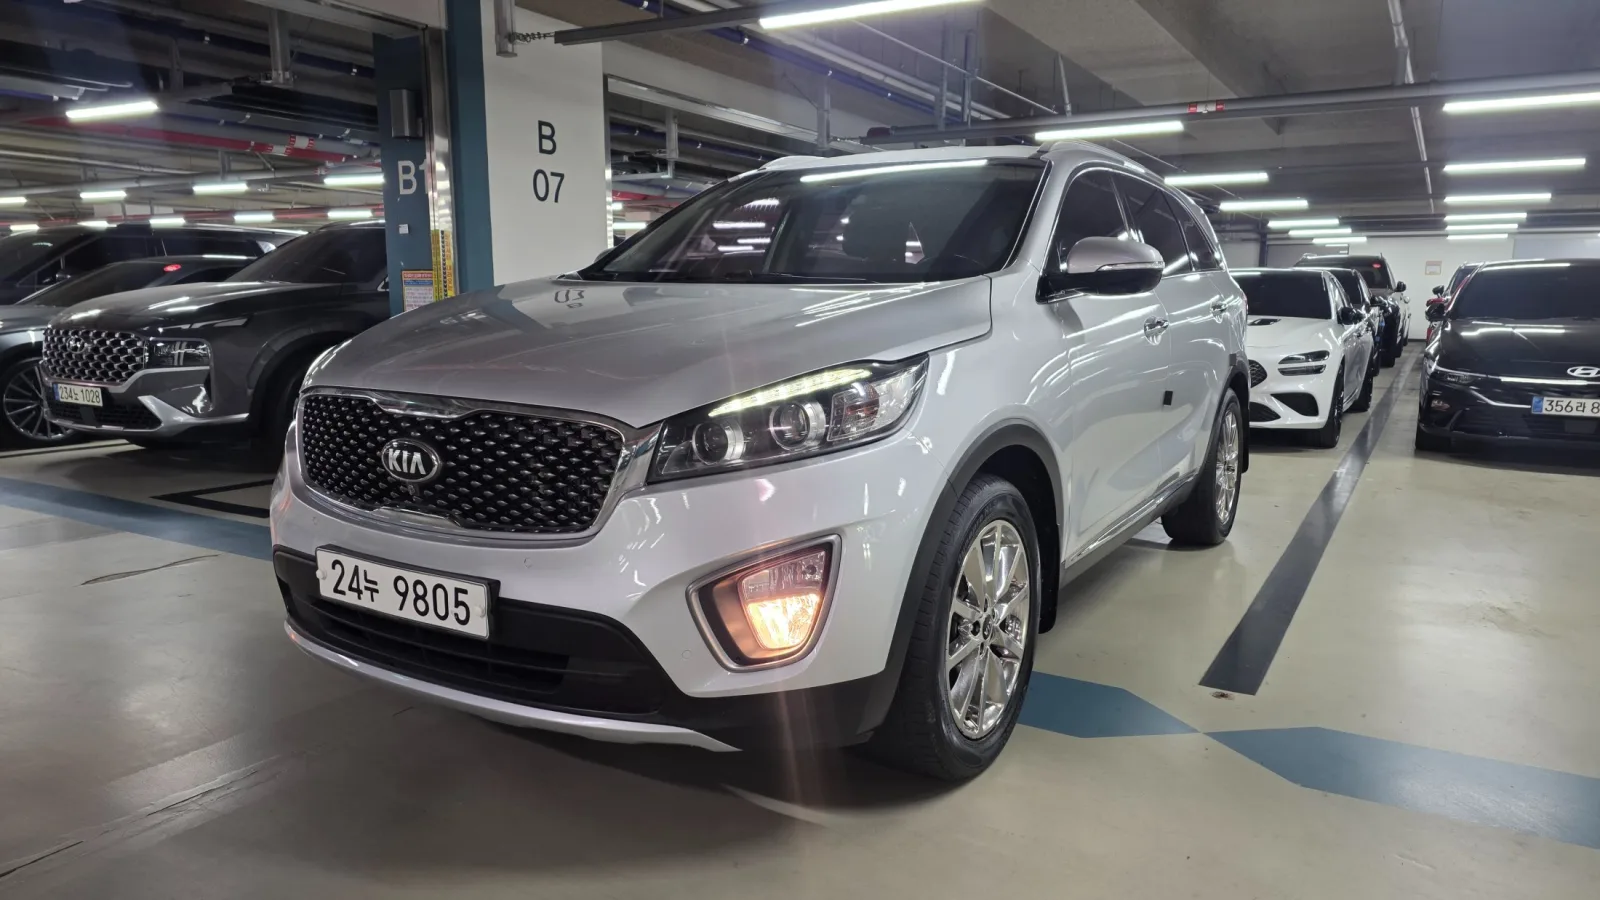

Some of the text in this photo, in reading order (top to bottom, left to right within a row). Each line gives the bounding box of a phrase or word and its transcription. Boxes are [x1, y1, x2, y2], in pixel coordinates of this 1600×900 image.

[538, 120, 557, 155] B
[533, 169, 565, 203] 07
[81, 388, 101, 404] 1028
[1545, 400, 1587, 413] 356라
[387, 449, 427, 476] KIA
[331, 560, 471, 626] 24누 9805
